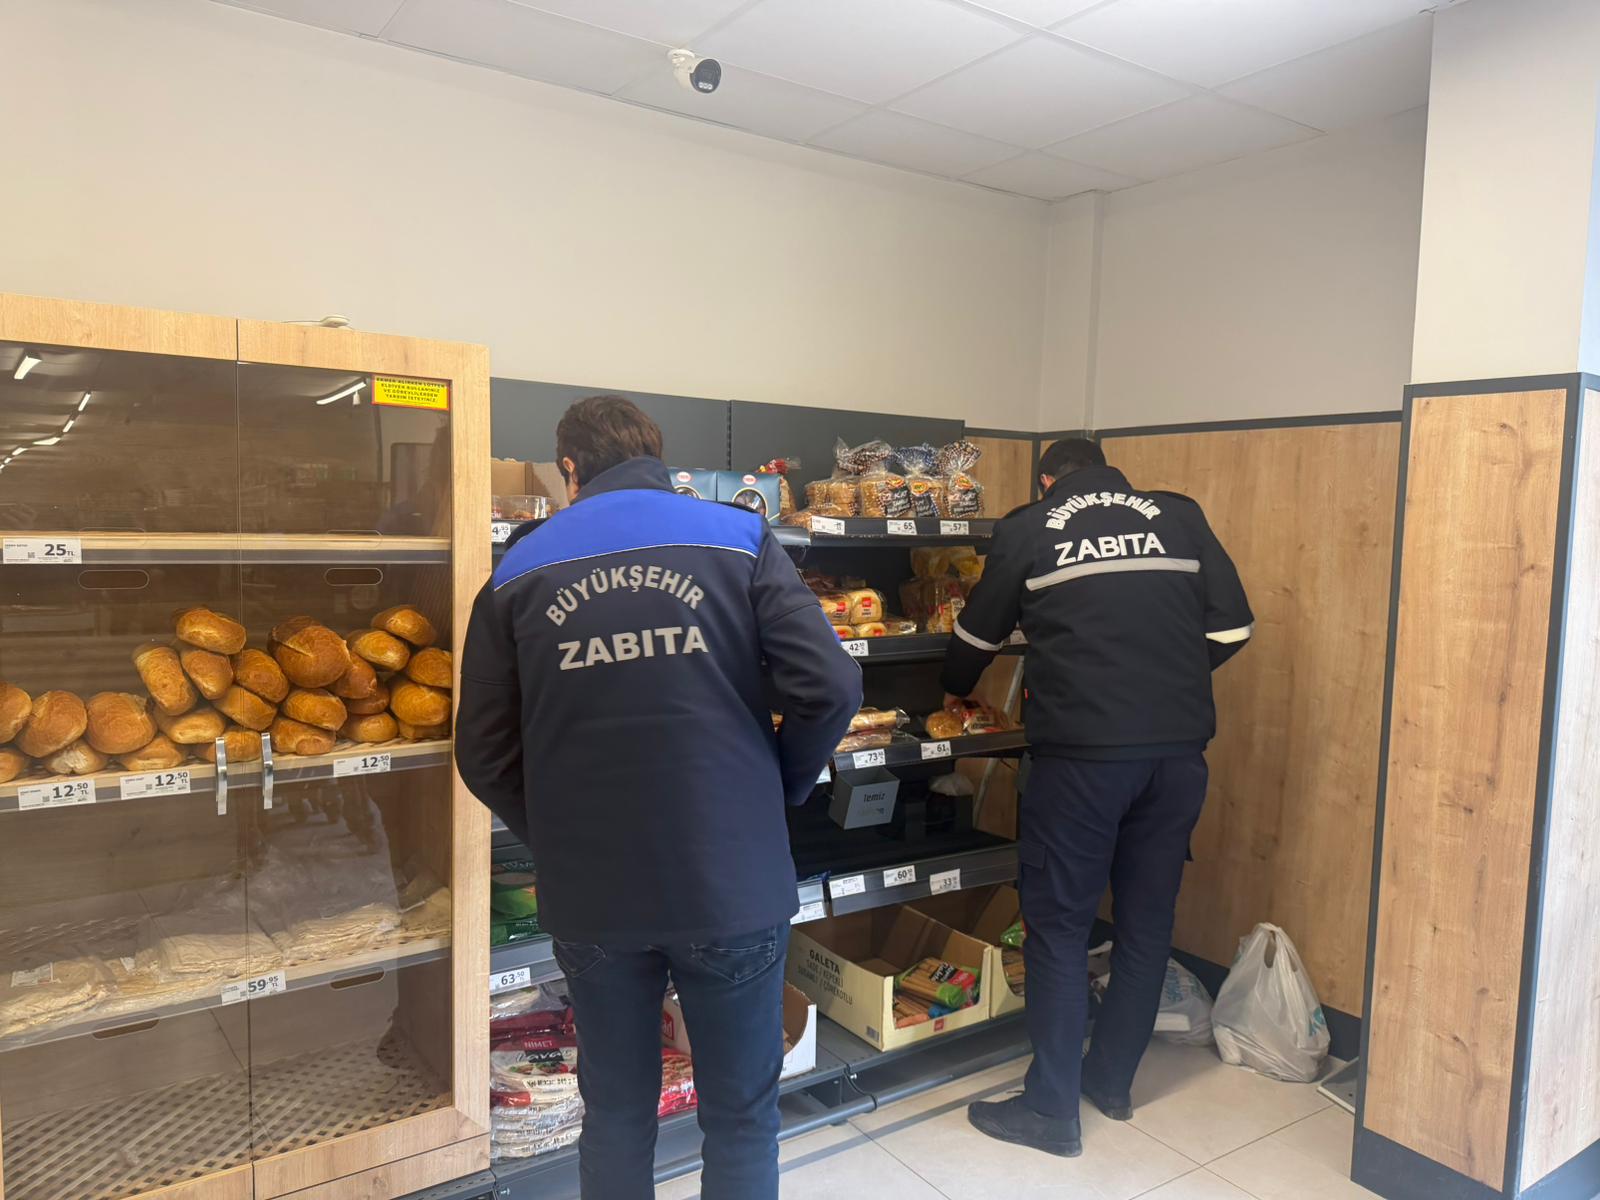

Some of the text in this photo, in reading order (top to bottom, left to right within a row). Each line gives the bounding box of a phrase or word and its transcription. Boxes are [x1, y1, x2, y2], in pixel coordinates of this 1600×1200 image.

[1045, 491, 1161, 530] BÜYÜKŞEHİR
[44, 543, 67, 556] 25
[1054, 532, 1166, 566] ZABITA
[545, 564, 705, 627] BÜYÜKŞEHİR
[558, 625, 709, 671] ZABITA
[809, 949, 840, 975] GALETA
